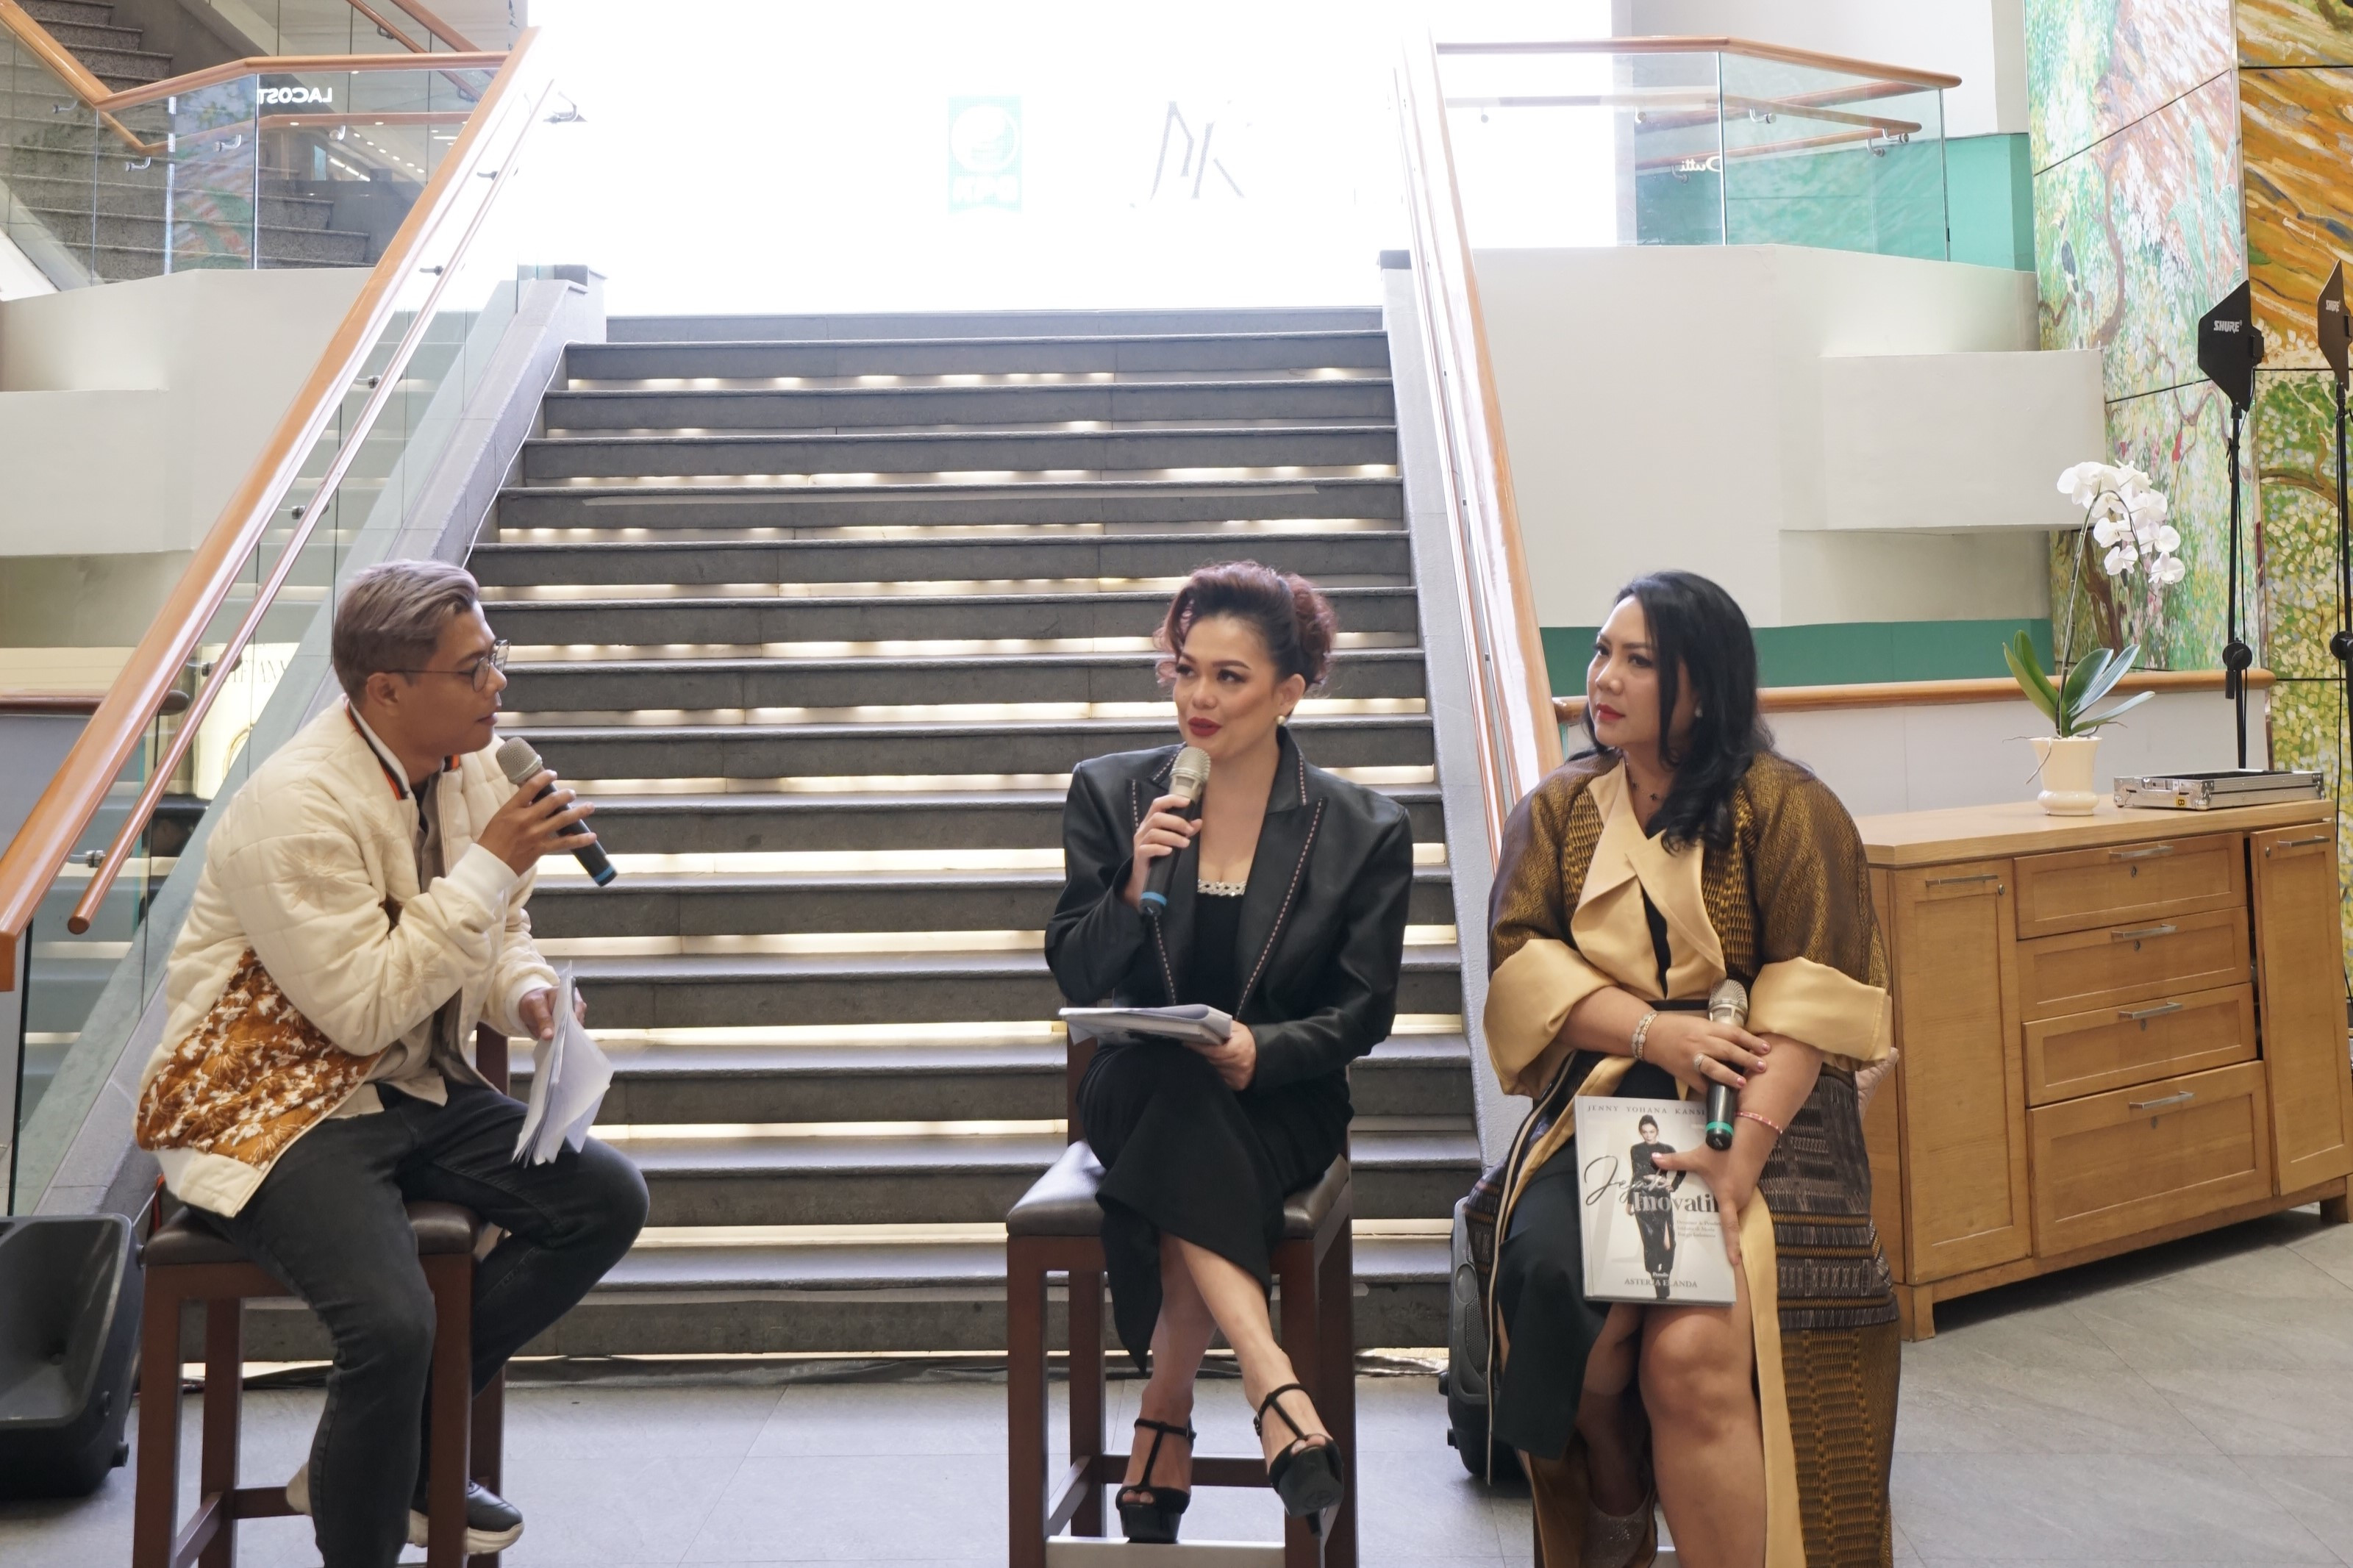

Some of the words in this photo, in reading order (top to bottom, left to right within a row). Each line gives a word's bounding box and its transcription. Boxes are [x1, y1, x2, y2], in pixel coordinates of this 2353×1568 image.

[2325, 299, 2340, 312] SHURE
[2213, 319, 2240, 334] SHURE
[1587, 1104, 1618, 1112] JENNY
[1626, 1106, 1668, 1114] YOHANA
[1624, 1278, 1660, 1286] ASTERIA
